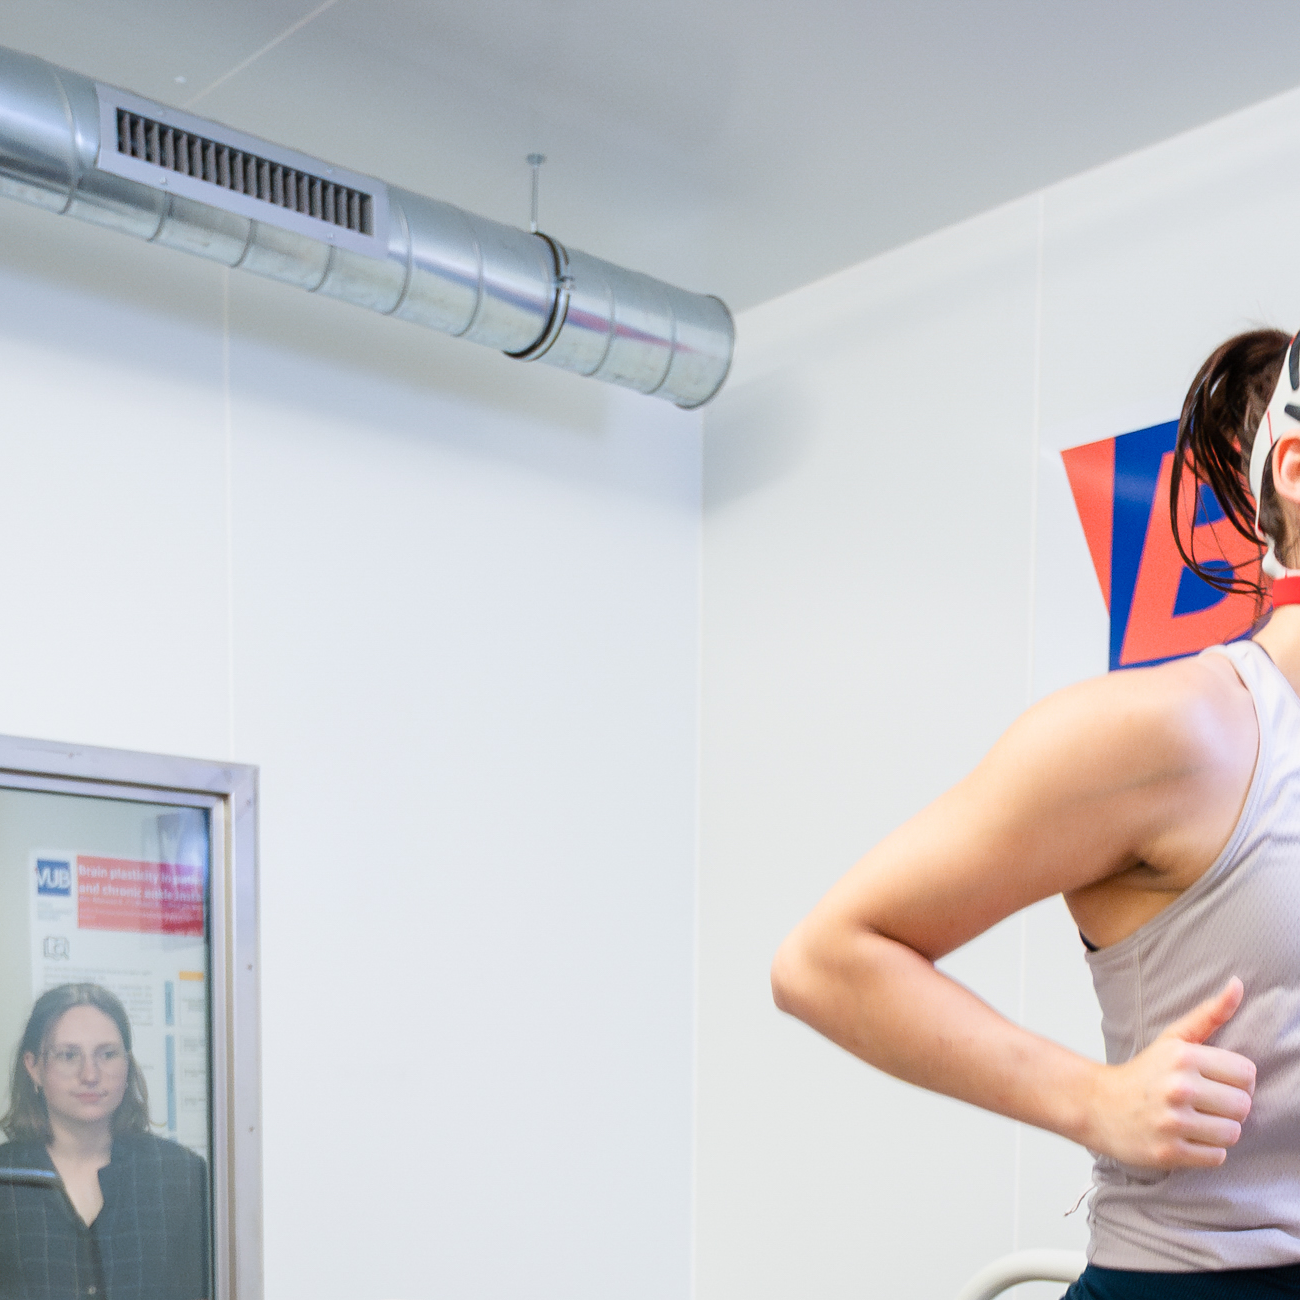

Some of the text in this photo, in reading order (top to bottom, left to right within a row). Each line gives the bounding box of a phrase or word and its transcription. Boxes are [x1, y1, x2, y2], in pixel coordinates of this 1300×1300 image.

[36, 867, 70, 889] VUB
[78, 864, 108, 878] Brain
[78, 883, 100, 896] and
[102, 885, 141, 898] chronic
